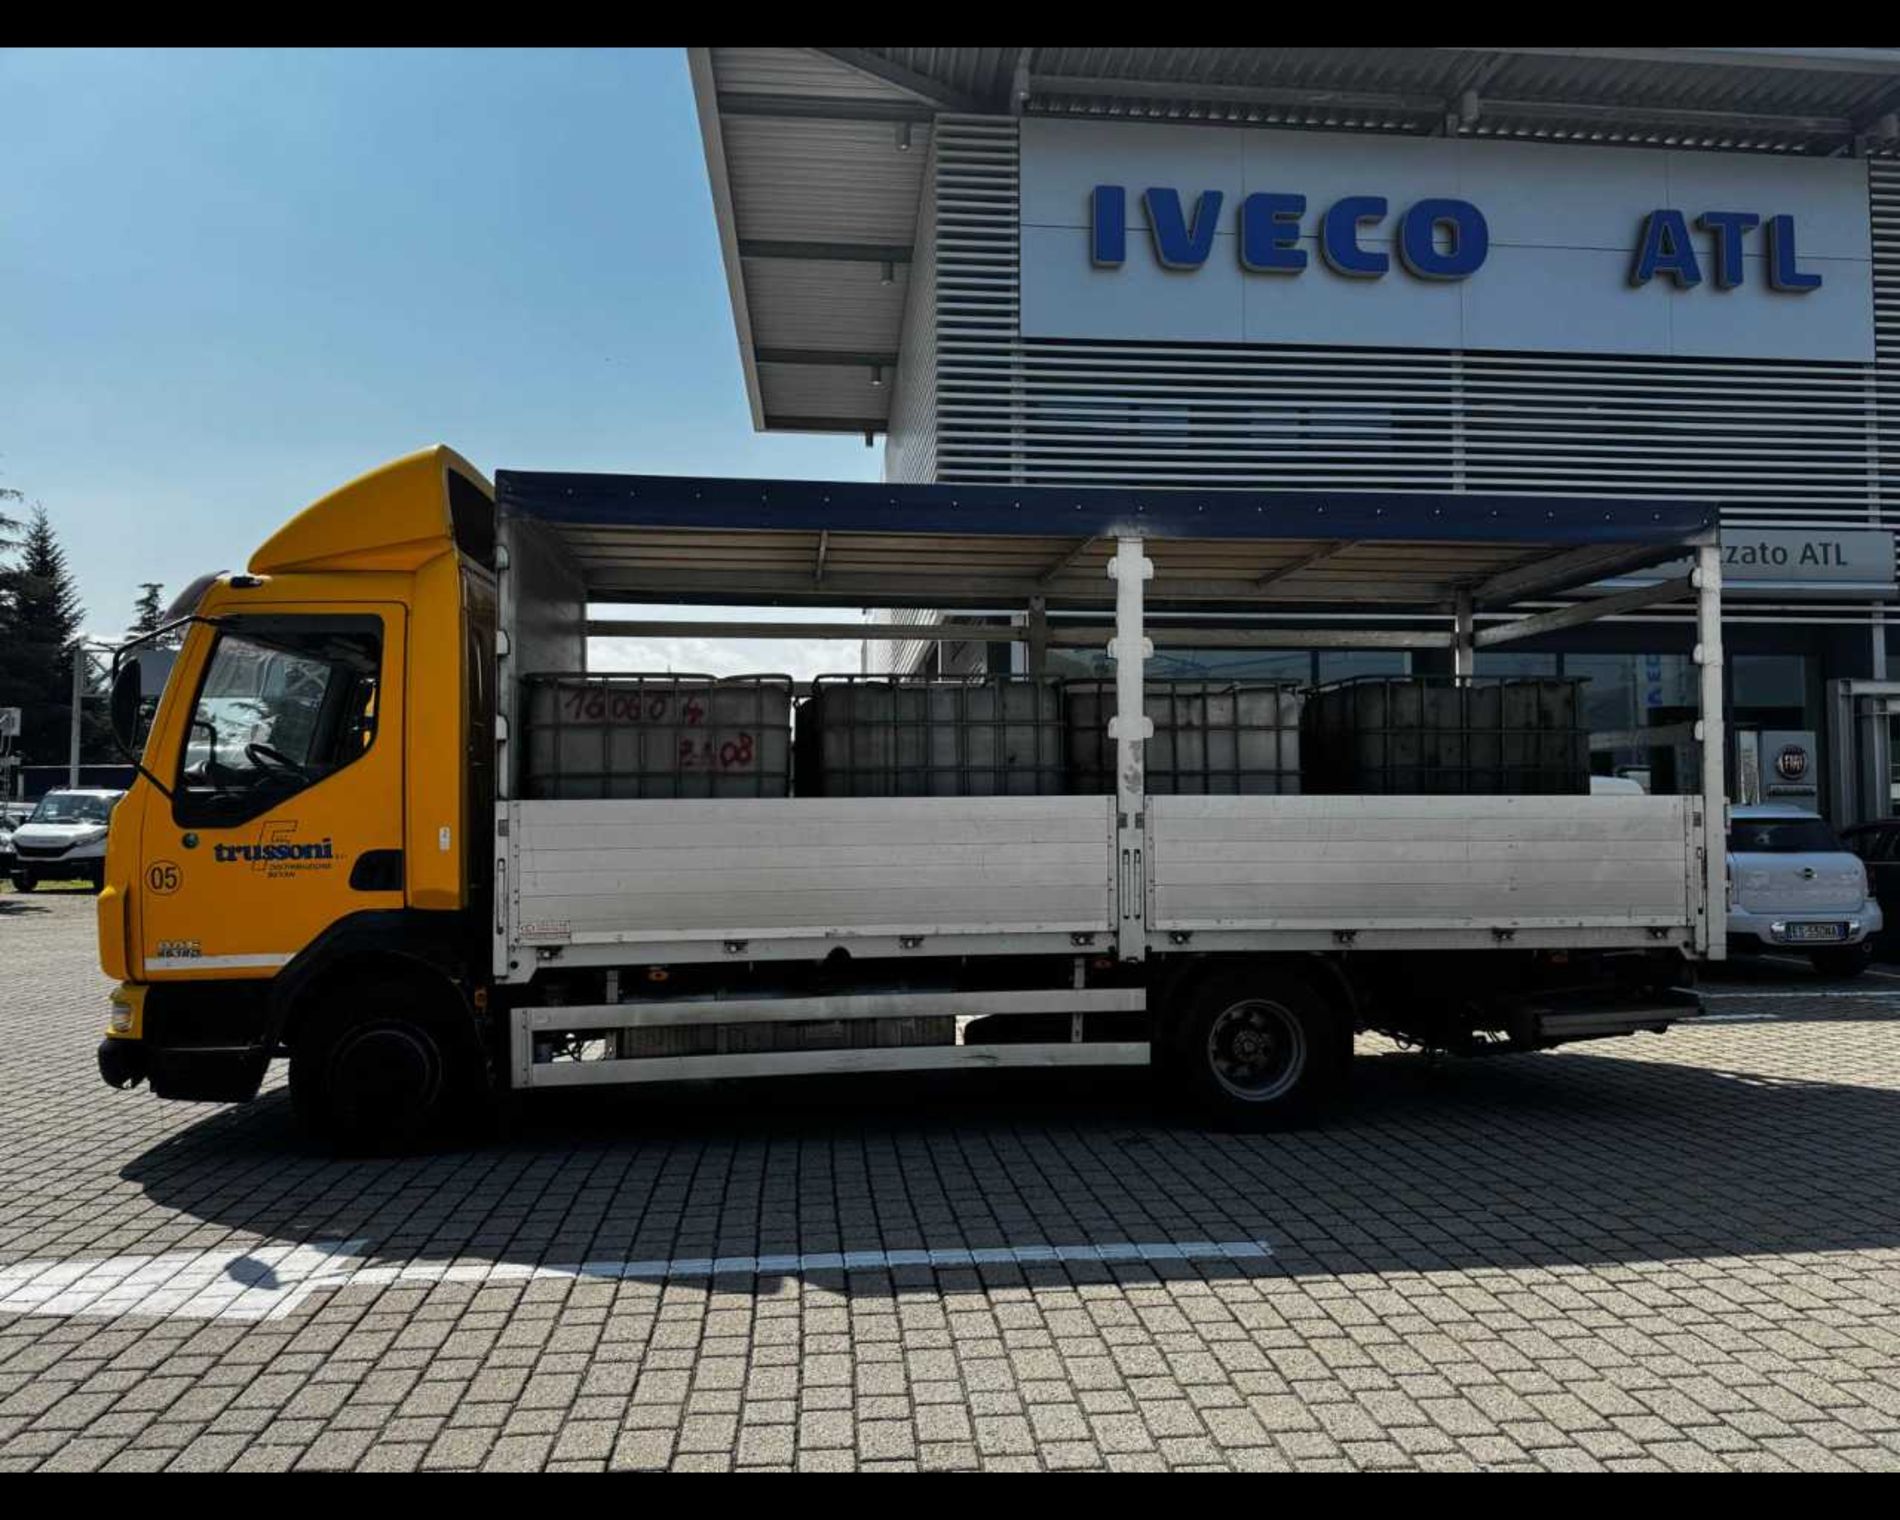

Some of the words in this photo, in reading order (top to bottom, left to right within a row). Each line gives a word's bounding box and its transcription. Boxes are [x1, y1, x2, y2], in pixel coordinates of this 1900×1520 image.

[1092, 185, 1488, 280] IVECO
[1629, 209, 1823, 292] ATL
[1720, 541, 1788, 566] zato
[1799, 541, 1848, 566] ATL
[213, 837, 333, 862] trussoni
[150, 867, 178, 890] 05
